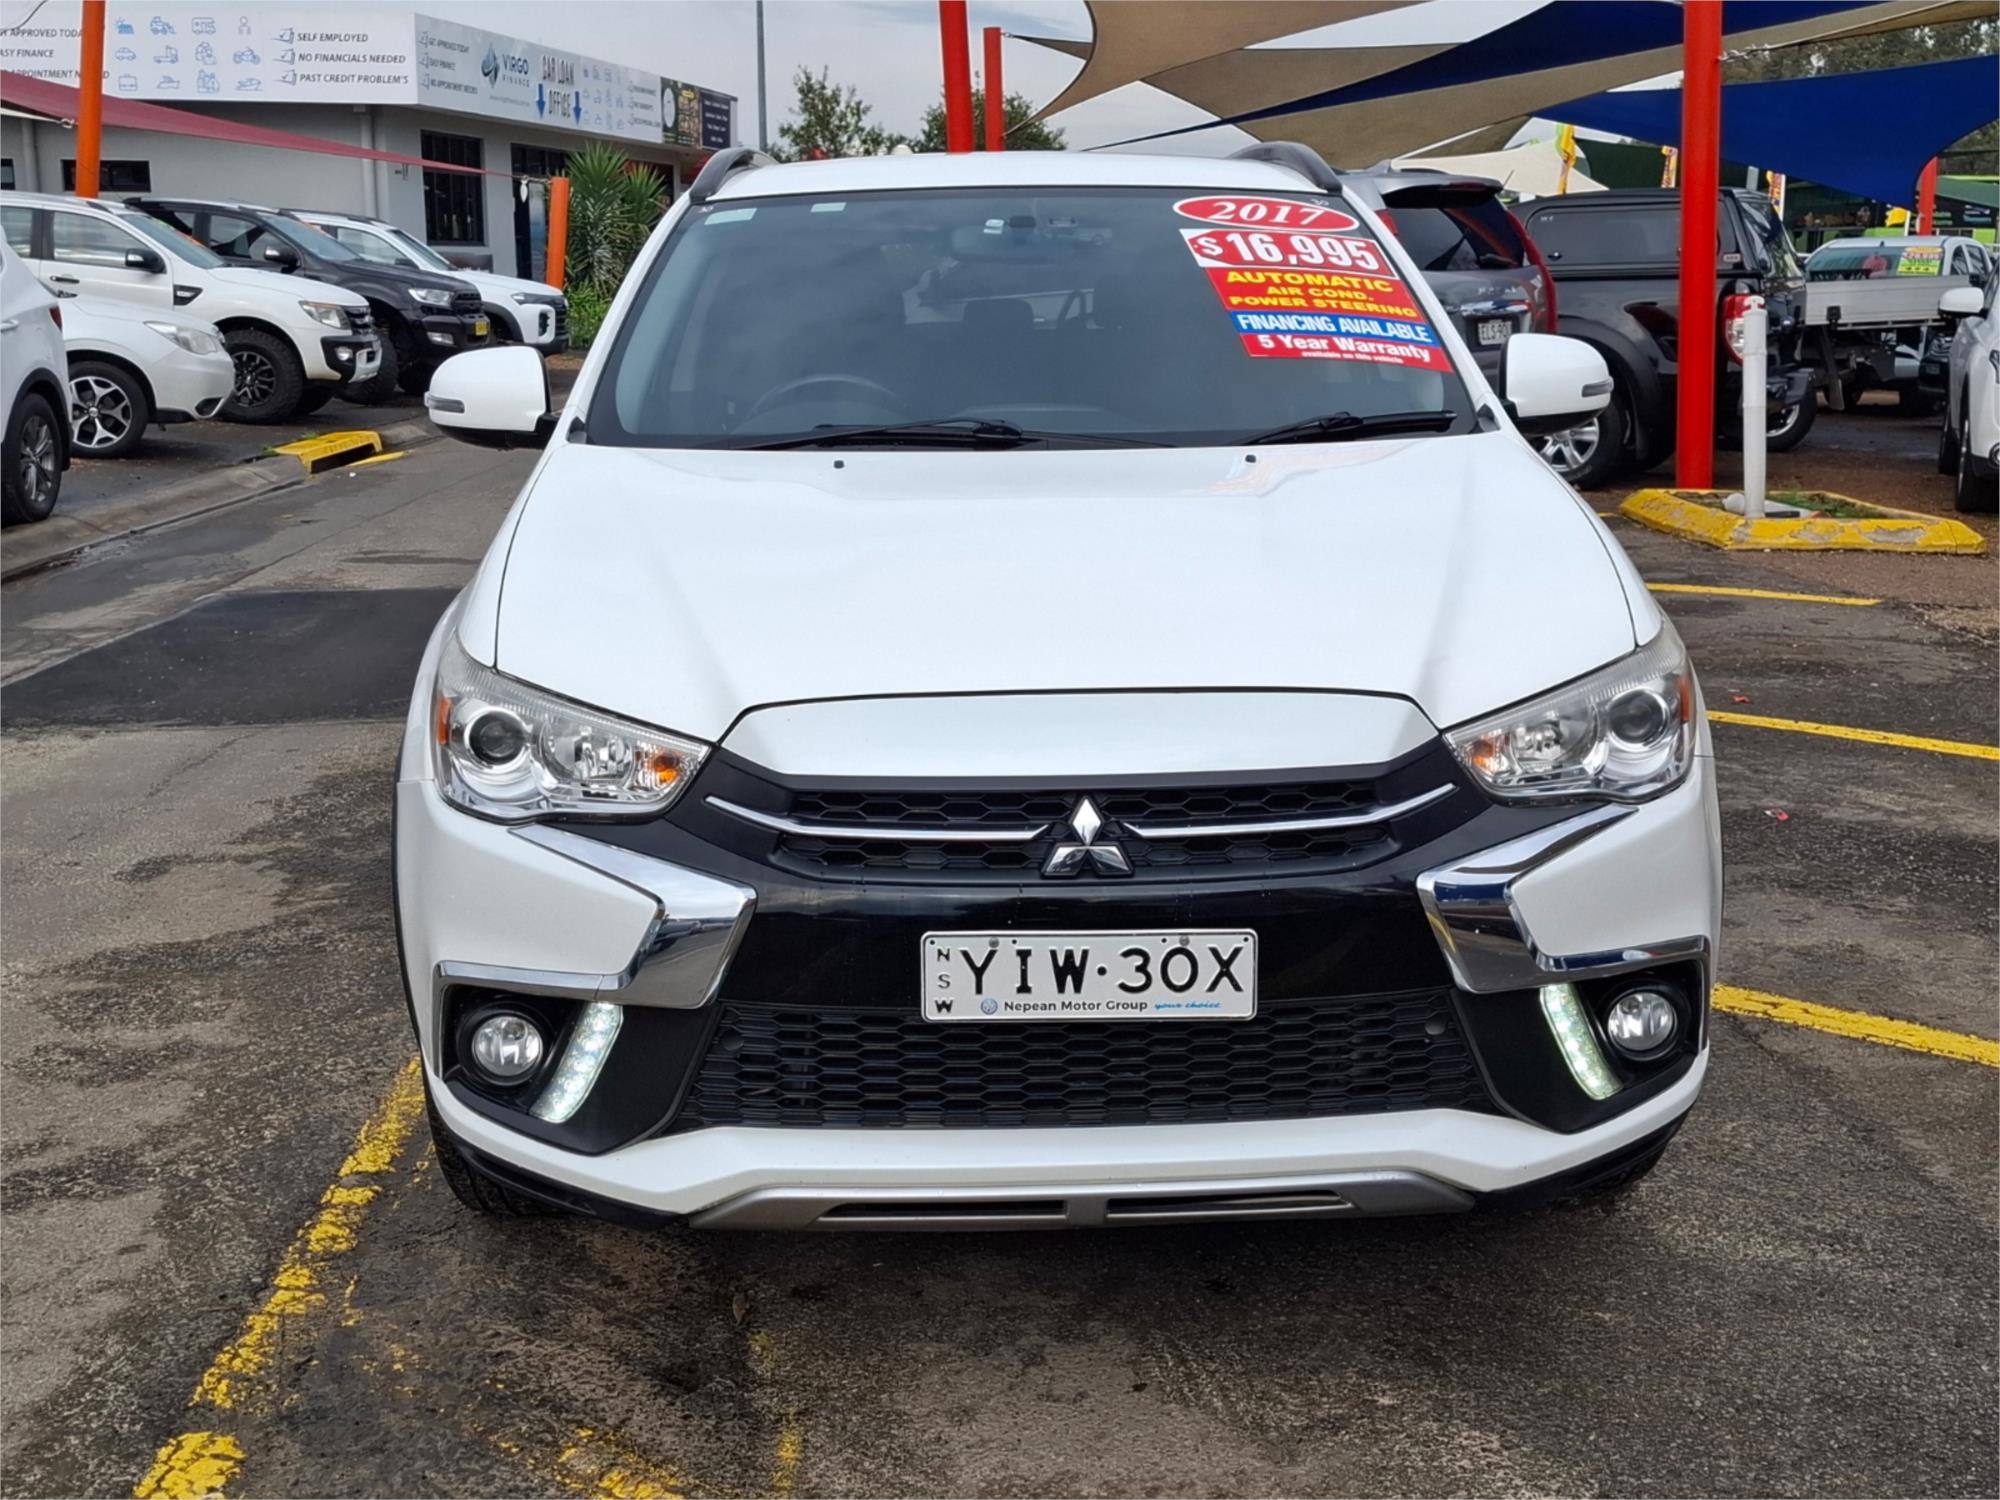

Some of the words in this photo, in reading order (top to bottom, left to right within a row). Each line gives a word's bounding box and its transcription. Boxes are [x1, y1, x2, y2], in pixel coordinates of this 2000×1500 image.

[60, 29, 83, 38] TODA
[297, 33, 318, 41] SELF
[320, 33, 368, 42] EMPLOYED
[17, 49, 54, 58] FINANCE
[299, 53, 312, 62] NO
[315, 53, 367, 63] FINANCIALS
[369, 54, 406, 63] NEEDED
[502, 54, 529, 75] VIRGO
[300, 73, 321, 82] PAST
[324, 74, 356, 83] CREDIT
[358, 74, 409, 84] PROBLEM'S
[549, 90, 571, 118] OFFICE
[1207, 201, 1327, 226] 2017
[1227, 271, 1394, 292] AUTOMATIC
[1266, 286, 1302, 296] AIR
[1308, 287, 1374, 302] COND.
[1230, 296, 1308, 308] POWER
[1315, 298, 1418, 318] STEERING
[1238, 313, 1337, 332] FINANCING
[1340, 317, 1432, 343] AVAILABLE
[1259, 334, 1274, 349] 5
[1276, 334, 1329, 350] Year
[1335, 336, 1431, 363] Warranty
[1004, 1000, 1057, 1013] Nepean
[1060, 999, 1102, 1012] Motor
[1105, 999, 1148, 1013] Group
